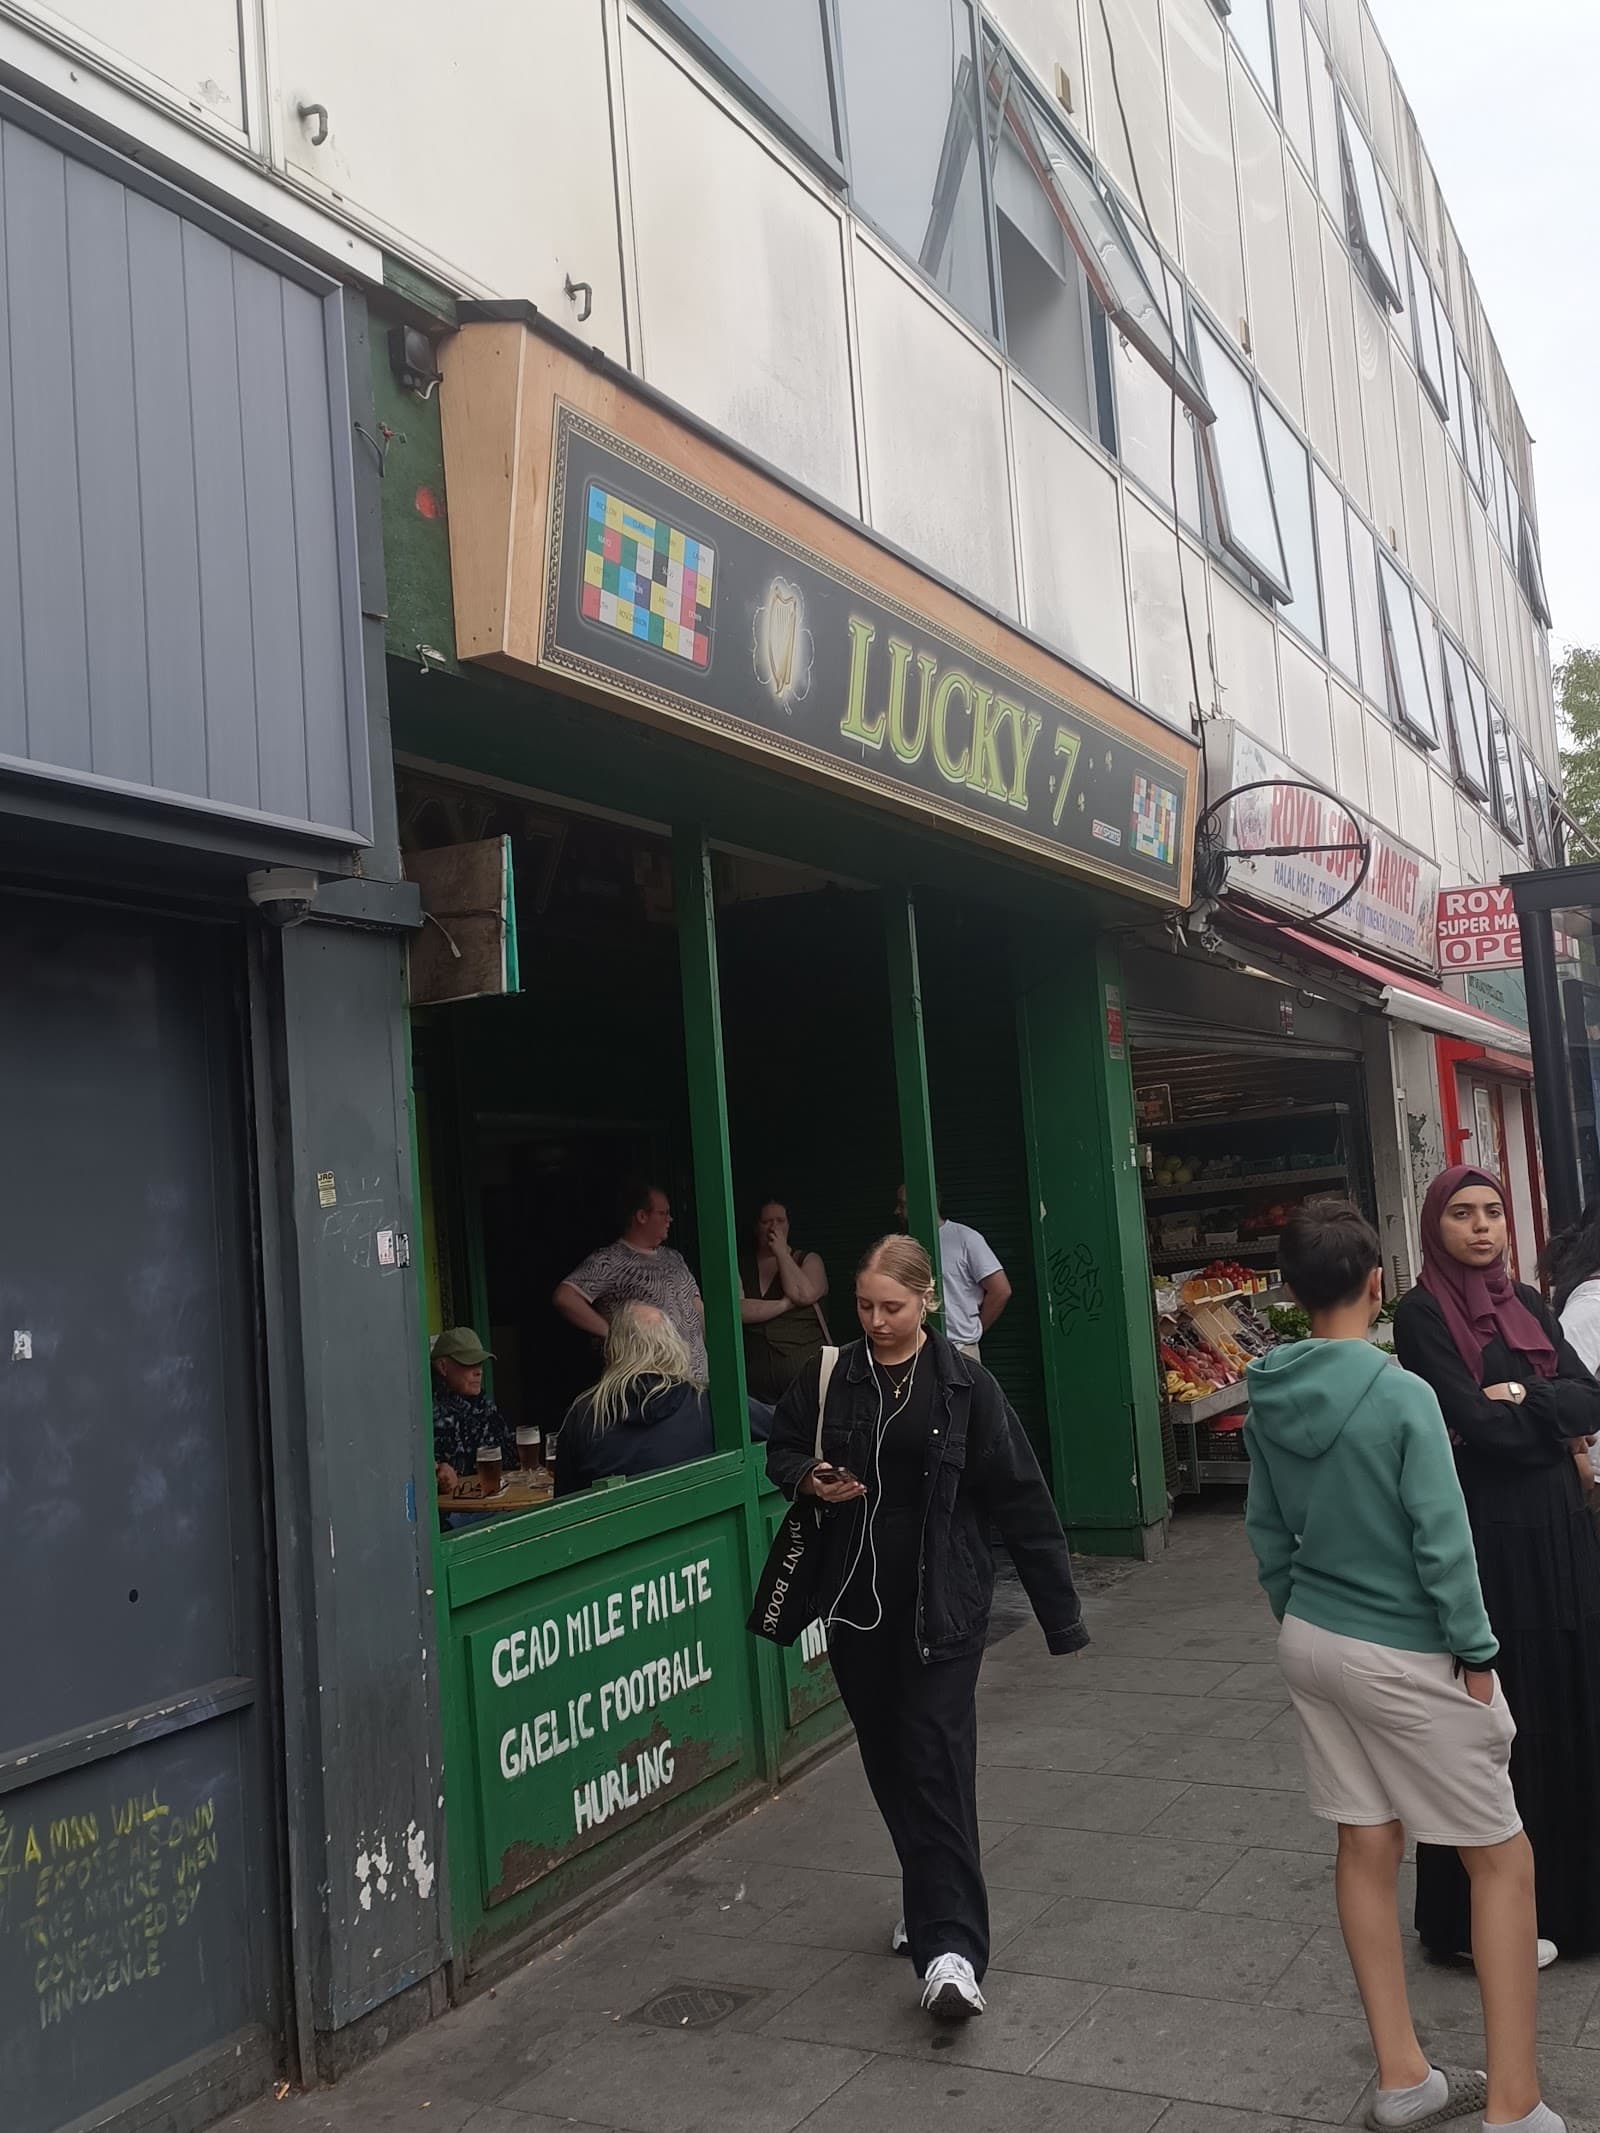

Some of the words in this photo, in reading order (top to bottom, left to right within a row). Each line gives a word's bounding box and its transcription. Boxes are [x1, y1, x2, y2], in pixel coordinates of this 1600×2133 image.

[841, 615, 1042, 810] LUCKY
[1052, 730, 1081, 825] 7
[1271, 776, 1322, 867] ROYAL
[1273, 859, 1295, 892] HALAL
[1297, 871, 1314, 899] MEAT
[1446, 888, 1514, 916] ROY
[1438, 917, 1490, 937] SUPER
[1494, 912, 1520, 931] MA
[1445, 934, 1522, 964] OPE
[491, 1619, 560, 1688] CEAD
[566, 1592, 625, 1658] MILE
[631, 1558, 712, 1631] FAILTE
[763, 1578, 789, 1635] BOOKS
[499, 1692, 595, 1780] GAELIC
[600, 1641, 712, 1732] FOOTBALL
[573, 1739, 675, 1834] HURLING
[25, 1824, 42, 1872] A
[50, 1812, 99, 1858] MAN
[168, 1797, 216, 1848] OWN
